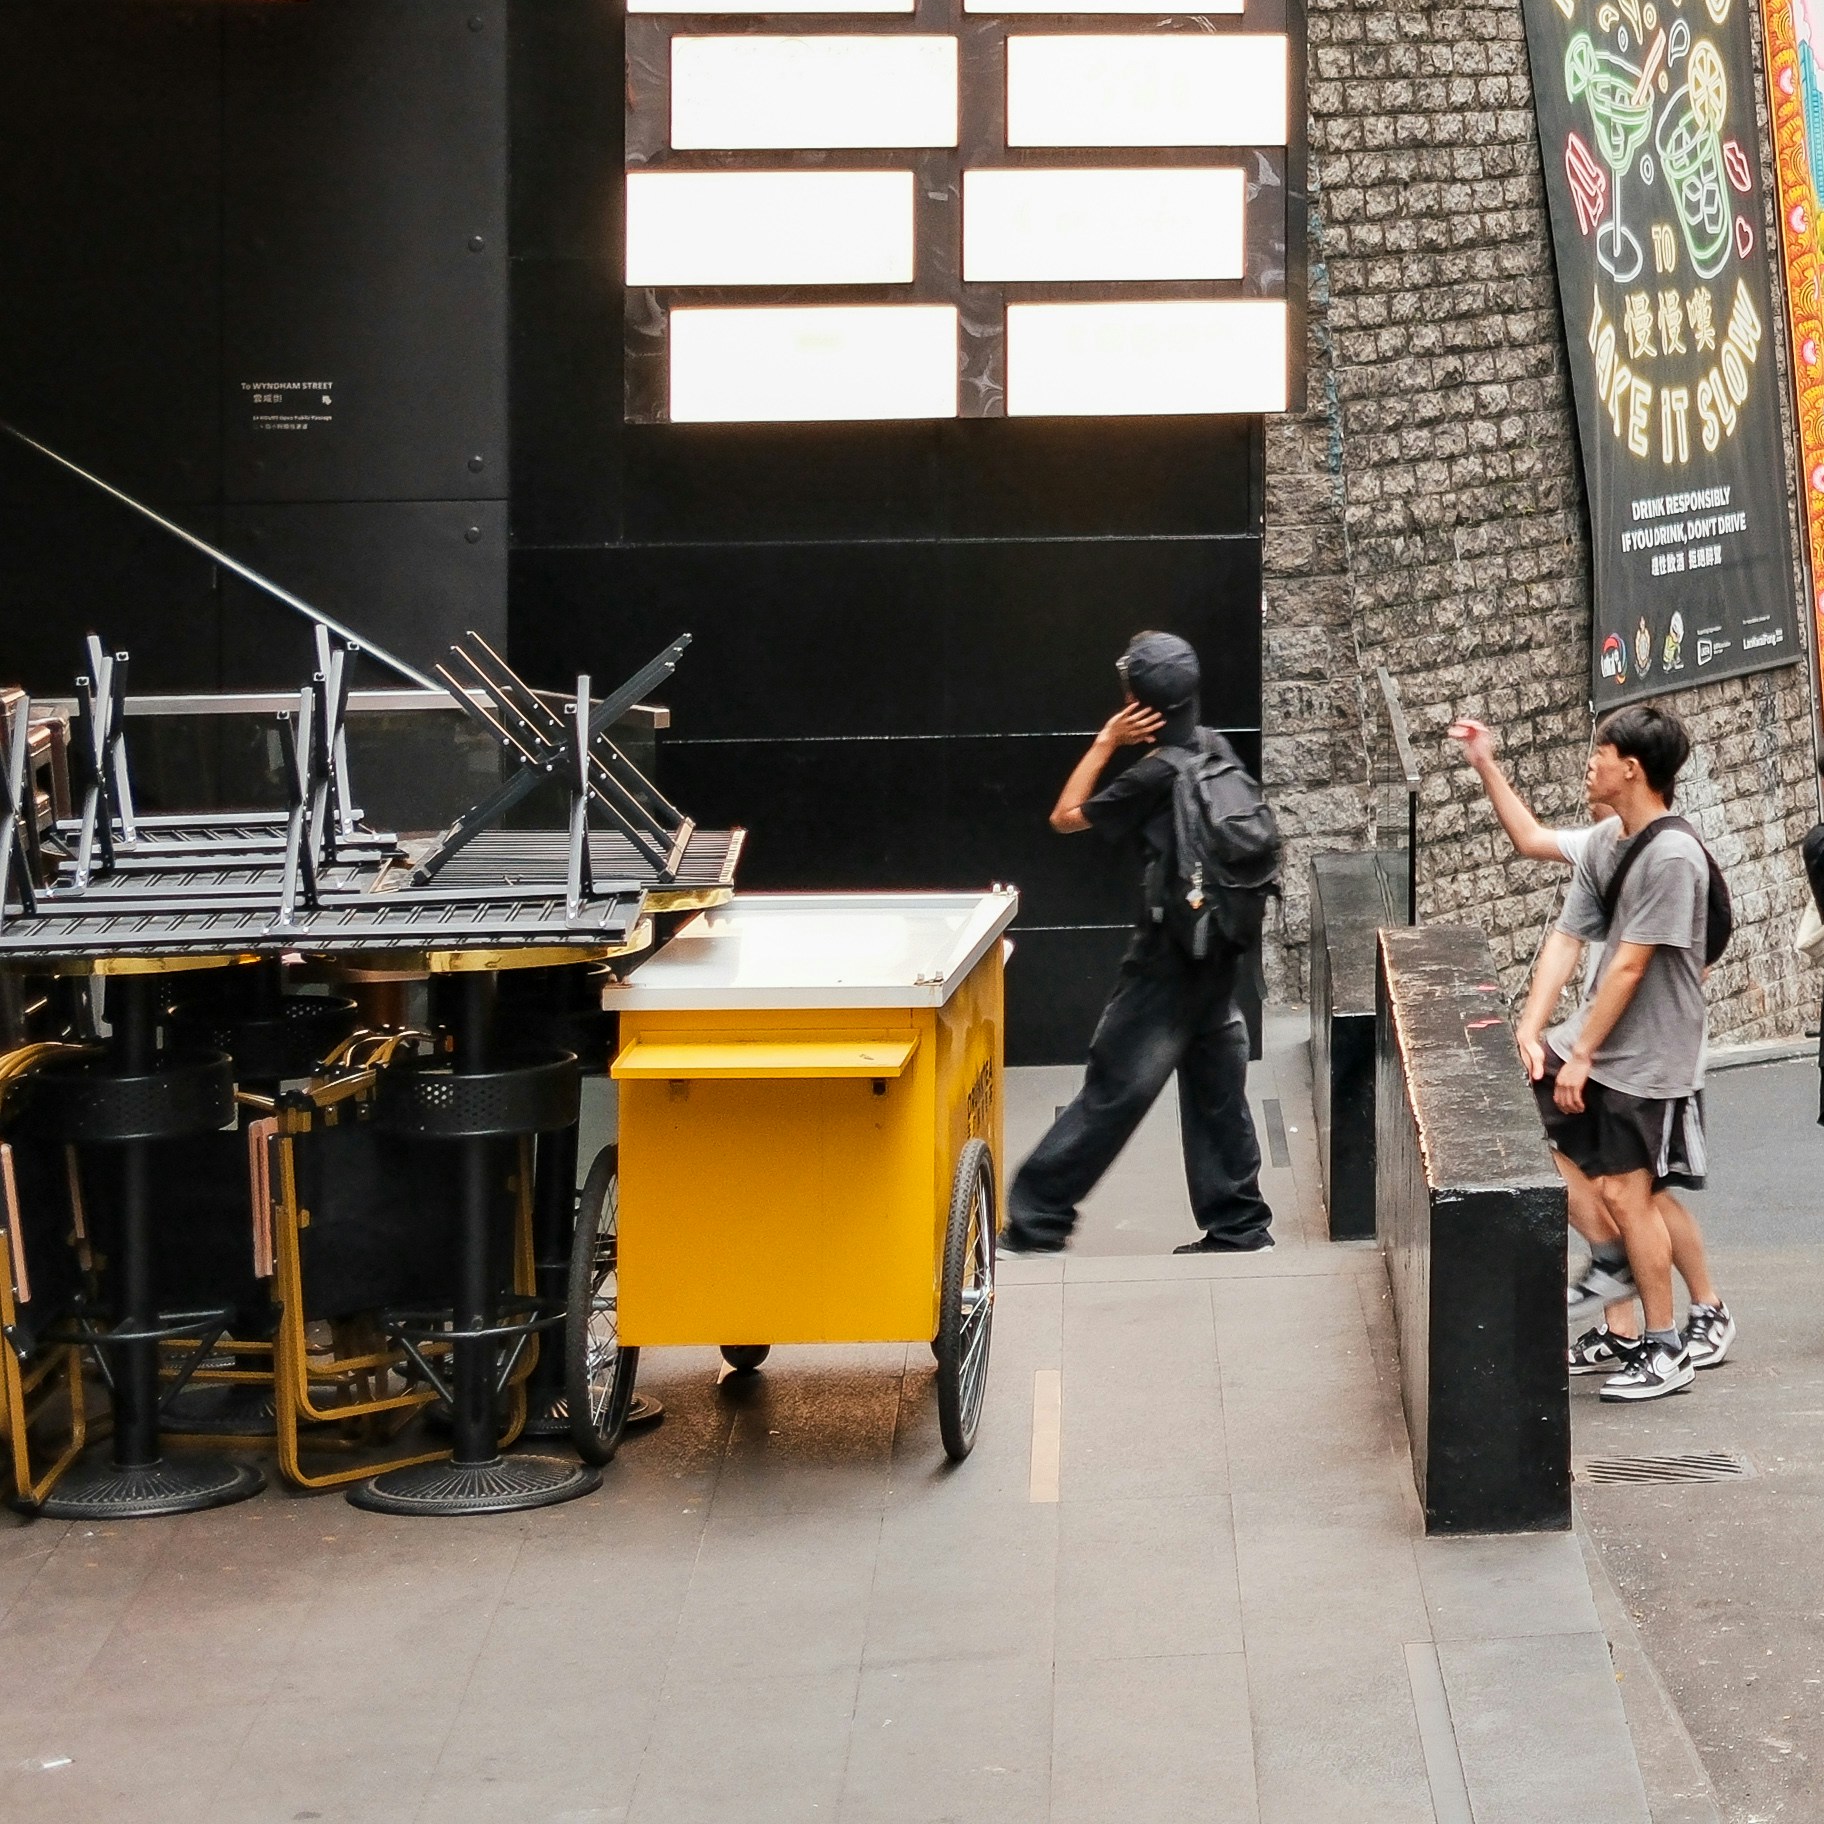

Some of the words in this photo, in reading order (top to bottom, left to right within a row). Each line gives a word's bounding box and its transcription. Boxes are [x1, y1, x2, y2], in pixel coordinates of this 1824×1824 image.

[253, 382, 301, 390] WYNDHAM
[302, 382, 333, 390] STREET
[1587, 283, 1654, 458] TAKE
[1661, 384, 1690, 465] IT
[1696, 277, 1763, 453] SLOW
[1631, 497, 1666, 522] DRINK
[1665, 485, 1731, 516] RESPONSIBLY
[1621, 531, 1632, 553] IF
[1631, 528, 1654, 552] YOU
[1654, 521, 1688, 546] DRINK,
[1687, 516, 1718, 540] DON'T
[1717, 511, 1747, 535] DRIVE
